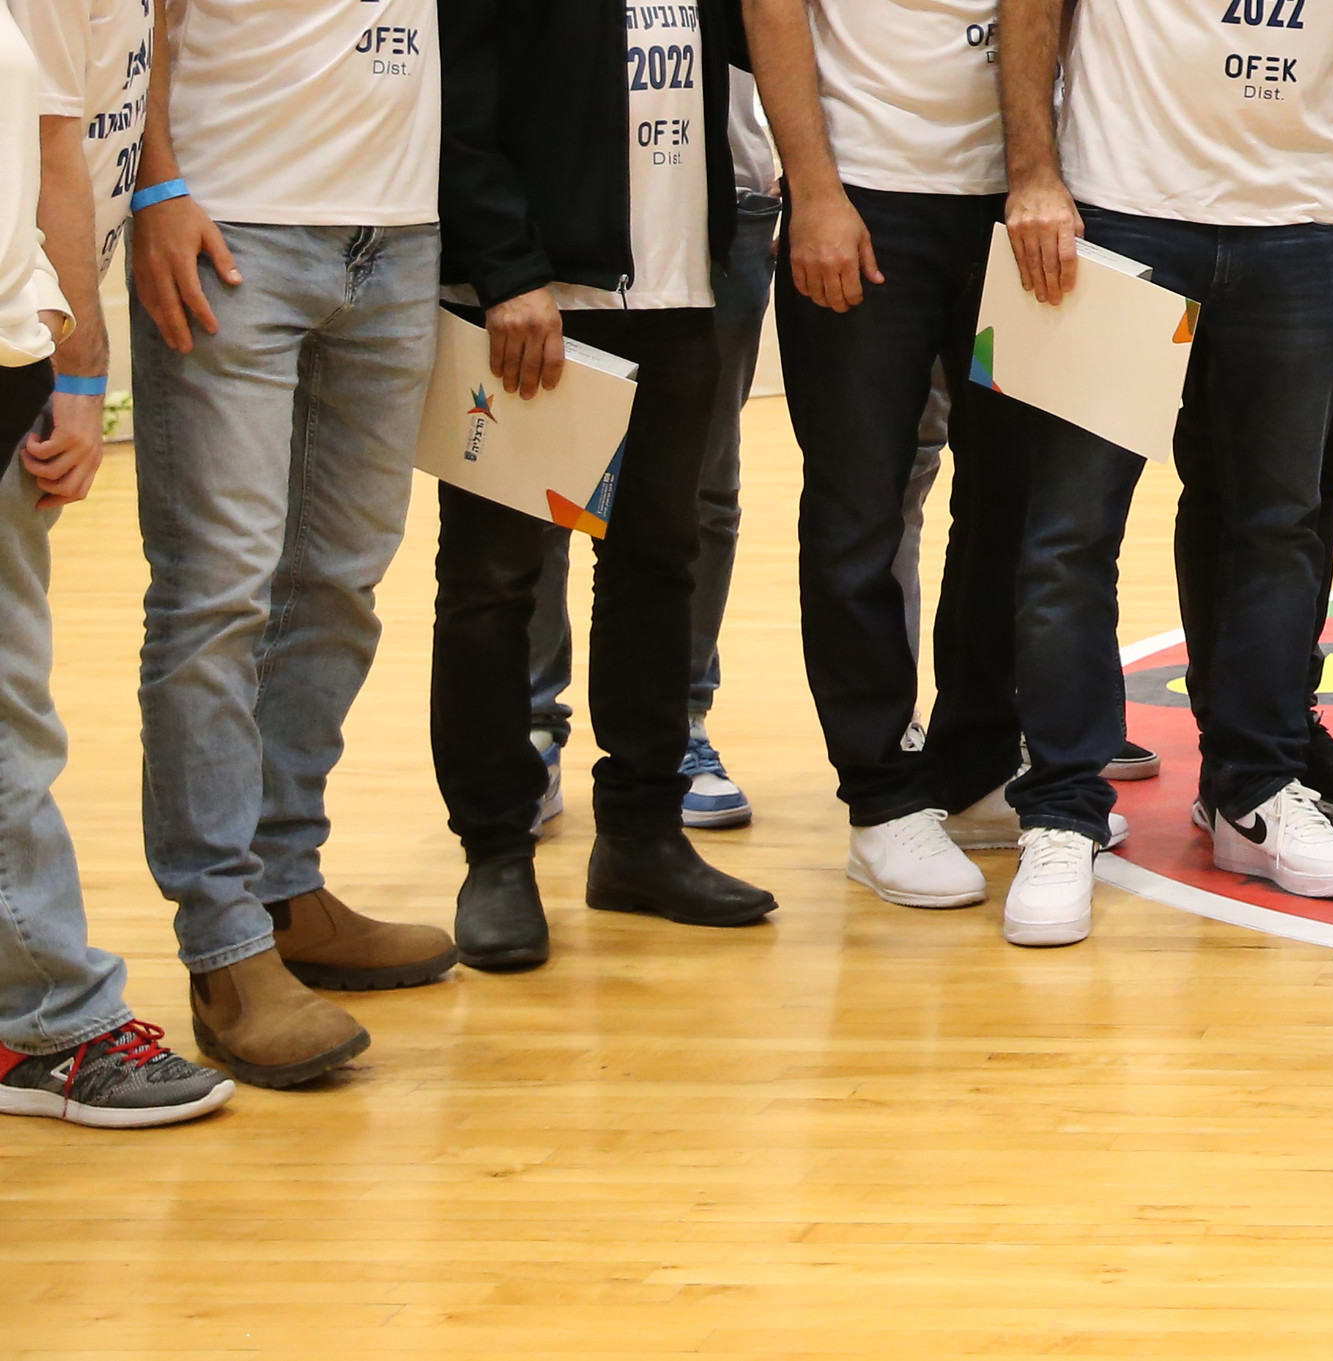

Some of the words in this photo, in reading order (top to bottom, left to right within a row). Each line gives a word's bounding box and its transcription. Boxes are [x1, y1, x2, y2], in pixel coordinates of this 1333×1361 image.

[644, 6, 675, 28] גביע
[355, 27, 420, 55] OFEK
[373, 61, 411, 76] Dist.
[628, 45, 694, 91] 2022
[1225, 53, 1297, 82] OFEK
[1243, 85, 1285, 100] Dist.
[638, 120, 689, 147] OFEK
[653, 151, 683, 165] Dist.
